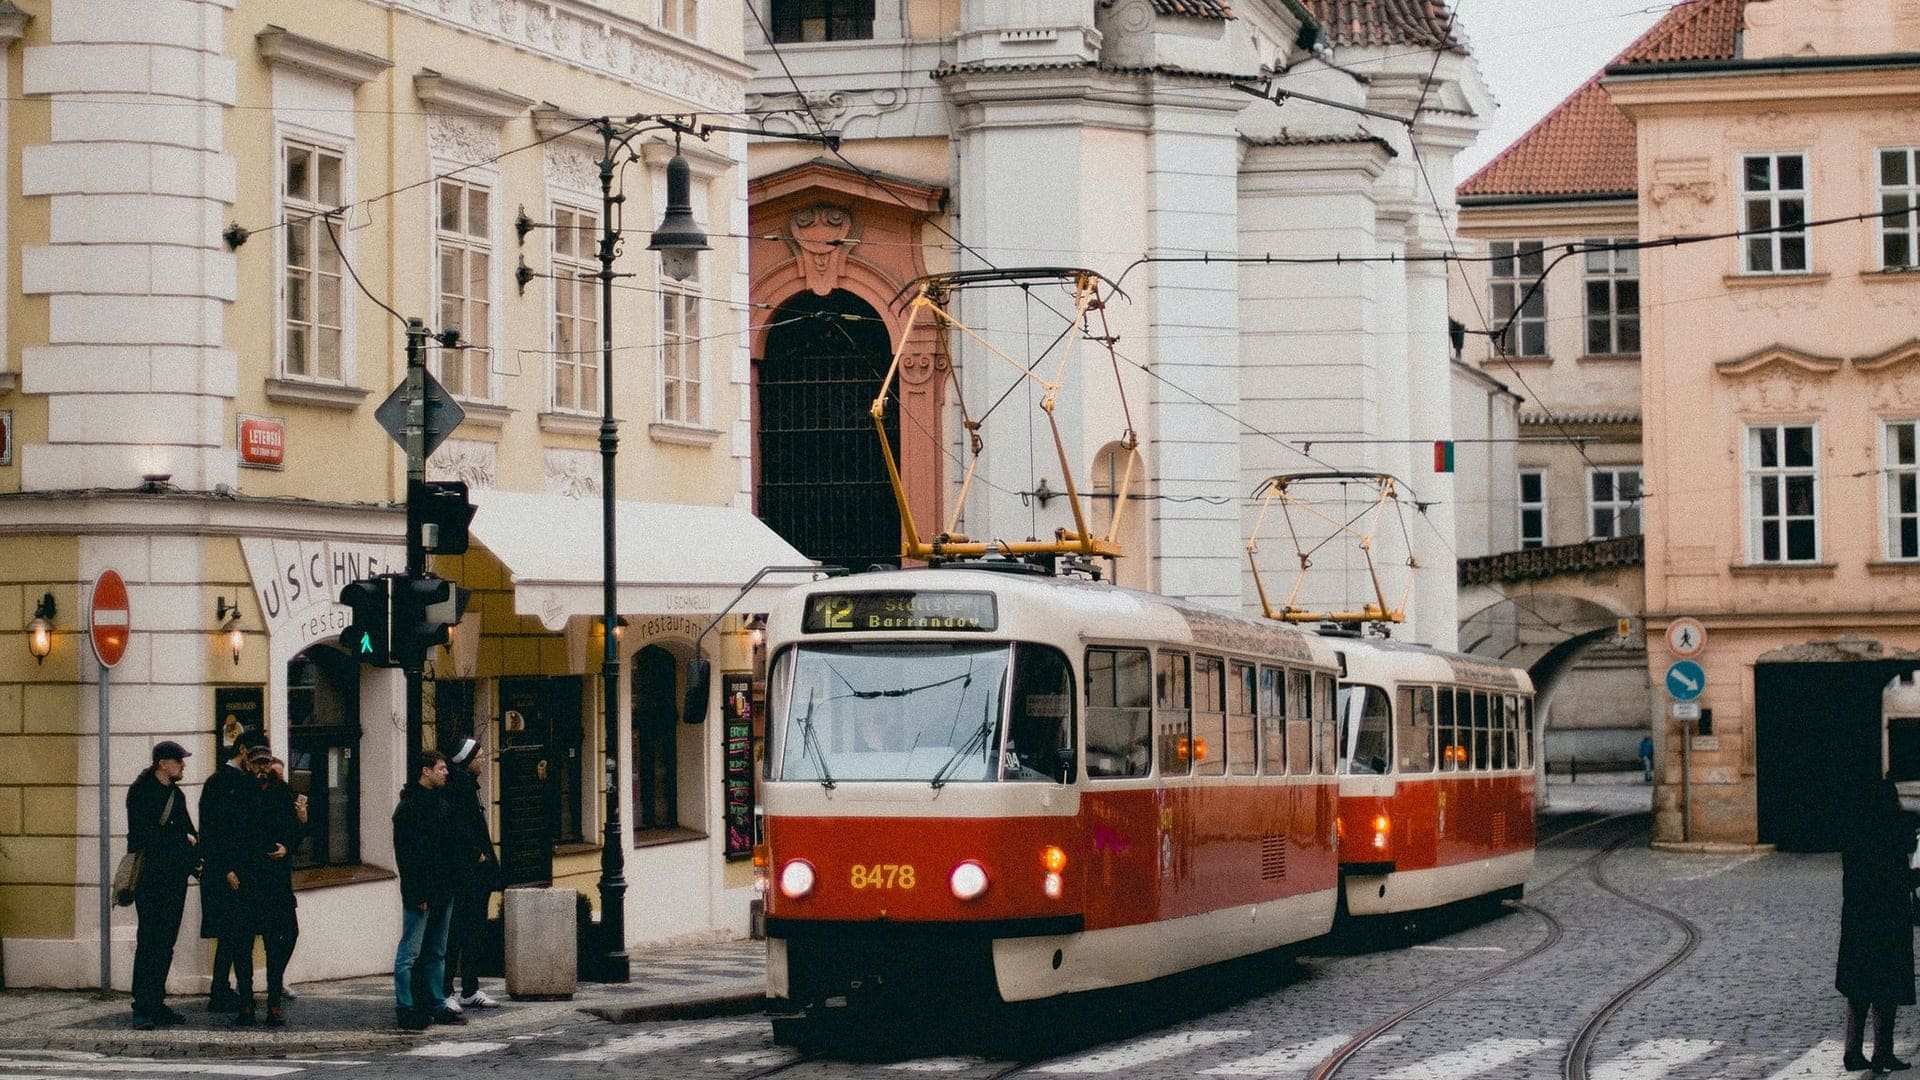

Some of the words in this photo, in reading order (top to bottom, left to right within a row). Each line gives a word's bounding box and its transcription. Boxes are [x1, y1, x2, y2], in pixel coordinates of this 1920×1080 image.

[301, 609, 352, 641] resta
[815, 597, 853, 628] 12
[868, 614, 980, 628] Barrandov
[850, 864, 916, 889] 8478
